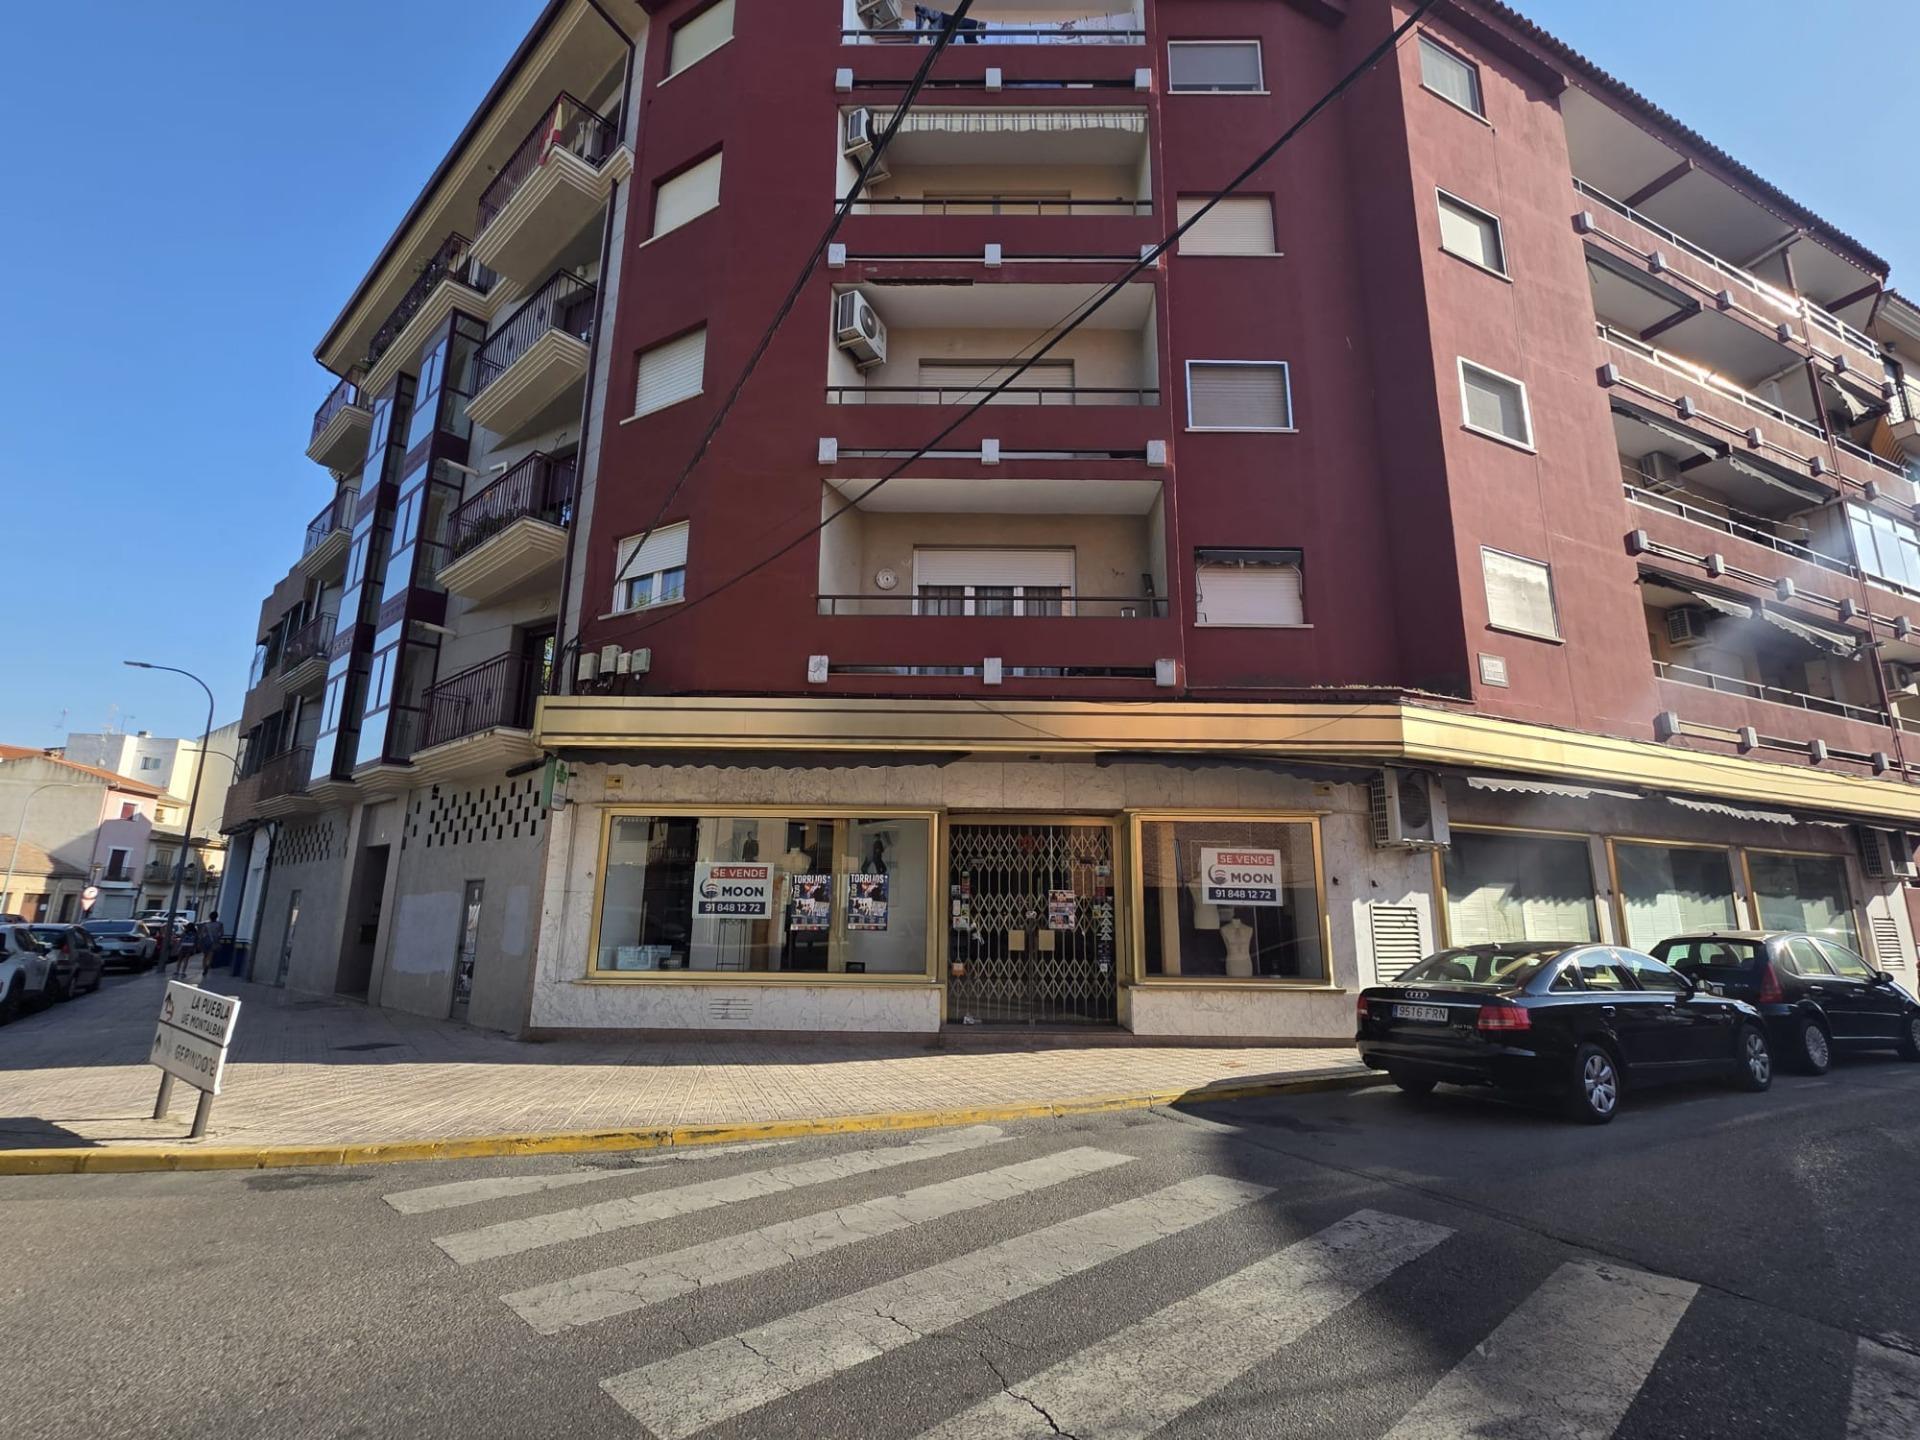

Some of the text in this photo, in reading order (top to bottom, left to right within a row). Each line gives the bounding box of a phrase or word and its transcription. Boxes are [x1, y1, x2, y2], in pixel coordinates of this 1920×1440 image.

[1220, 855, 1273, 865] SE VENDE
[713, 868, 767, 879] SE VENDE
[1231, 873, 1273, 884] MOON
[721, 886, 764, 897] MOON
[1215, 889, 1271, 899] 91 848 12 72
[705, 903, 760, 912] 91 848 12 72
[191, 994, 230, 1020] LA PUEBLA
[1399, 1006, 1446, 1019] 9516 FRN
